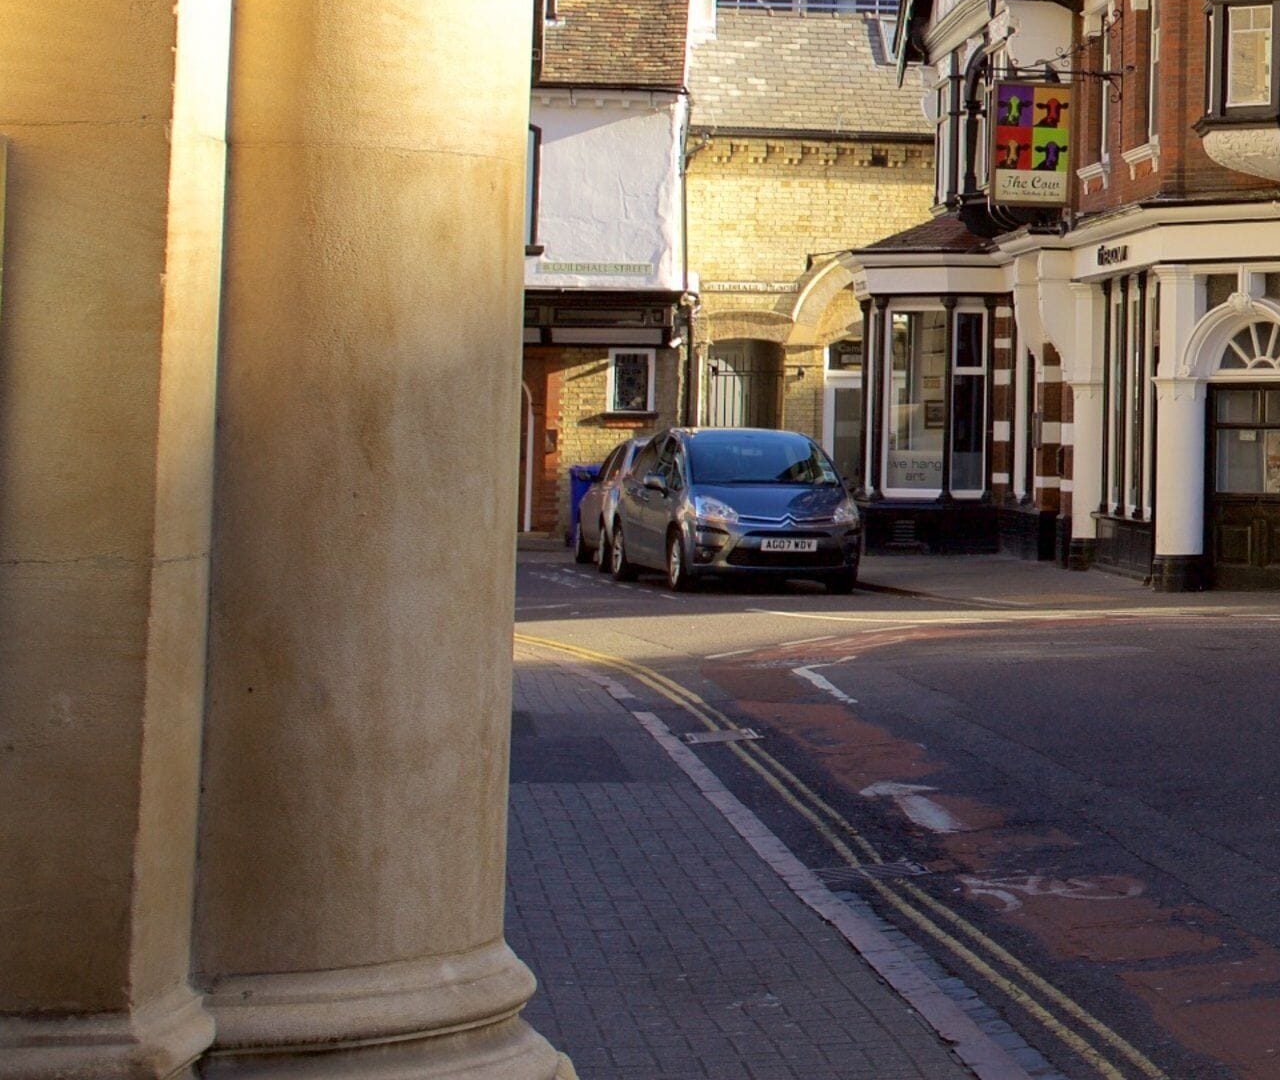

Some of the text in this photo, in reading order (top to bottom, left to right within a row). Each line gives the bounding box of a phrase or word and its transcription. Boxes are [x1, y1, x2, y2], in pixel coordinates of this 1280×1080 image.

[1002, 176, 1060, 190] The Cow
[552, 263, 650, 273] GUILDHALL STREET
[911, 458, 942, 472] hang
[905, 472, 926, 481] art
[766, 541, 791, 549] AG07
